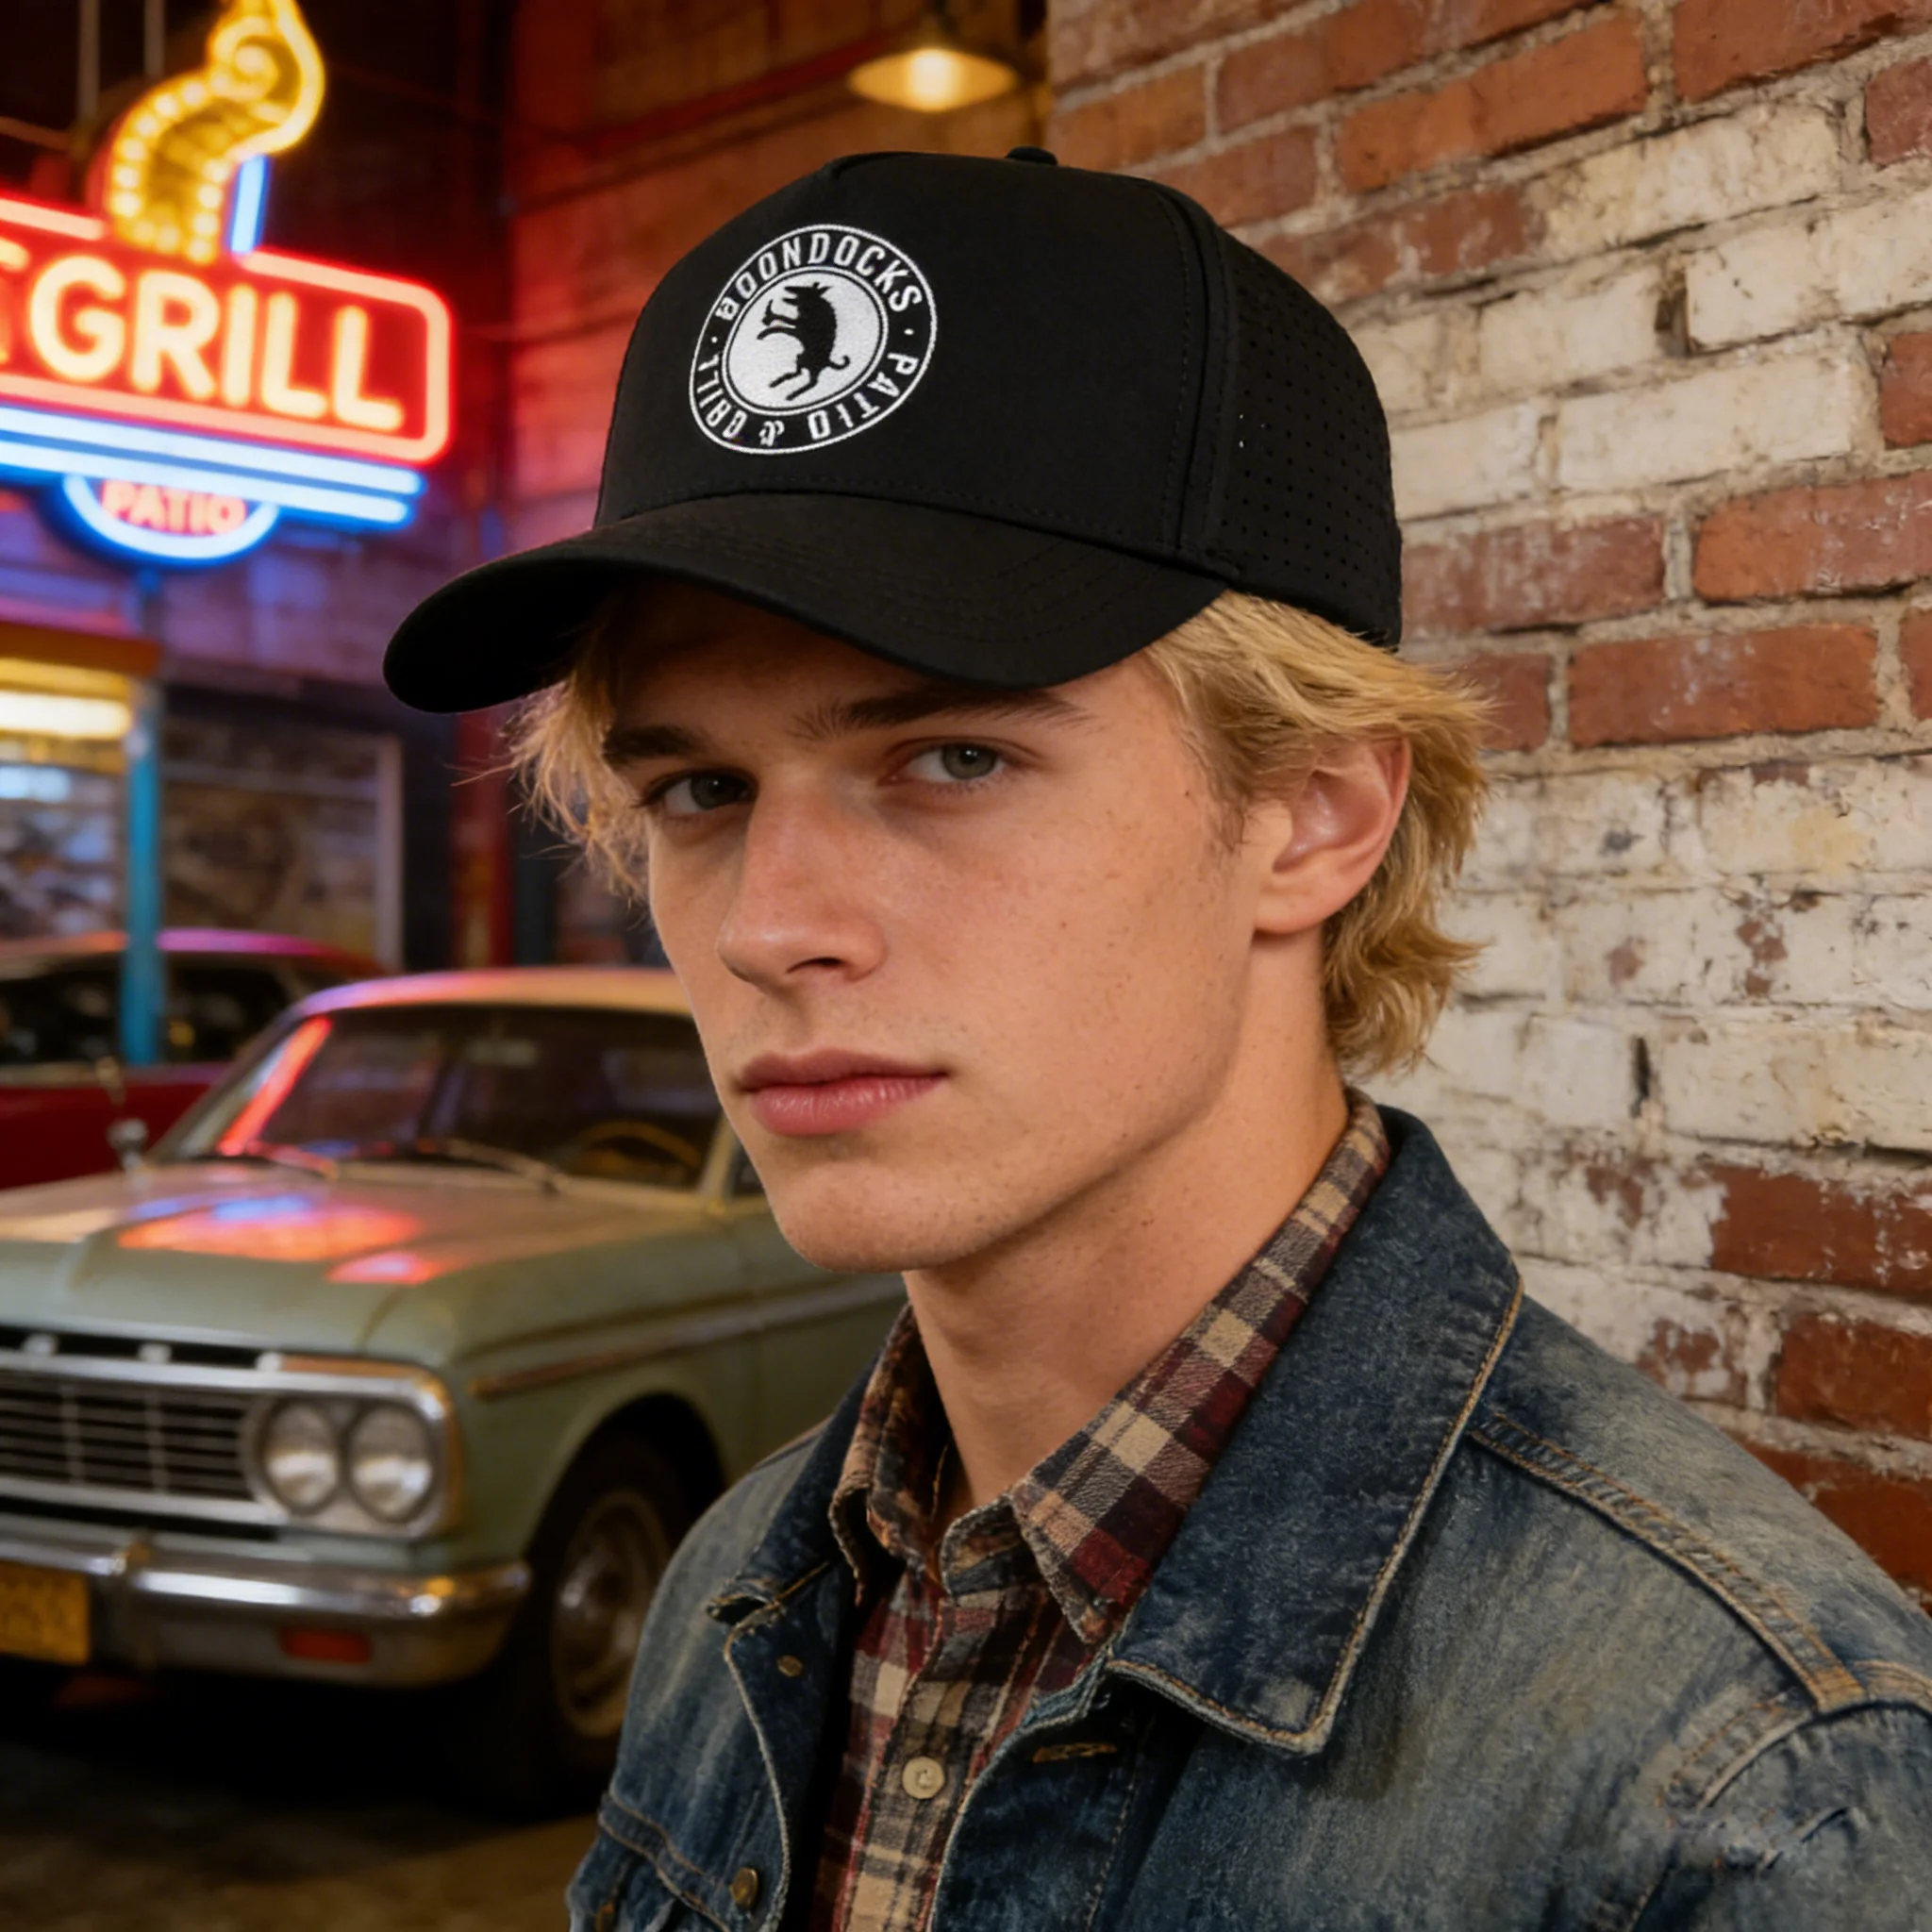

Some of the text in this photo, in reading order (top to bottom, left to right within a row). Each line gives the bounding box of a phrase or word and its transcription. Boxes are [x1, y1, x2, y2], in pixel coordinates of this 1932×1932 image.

[715, 232, 923, 321] BOONDOCKS
[29, 255, 405, 431] GRILL
[758, 420, 785, 447] &
[806, 353, 920, 441] PATIO
[101, 479, 247, 536] PATIO
